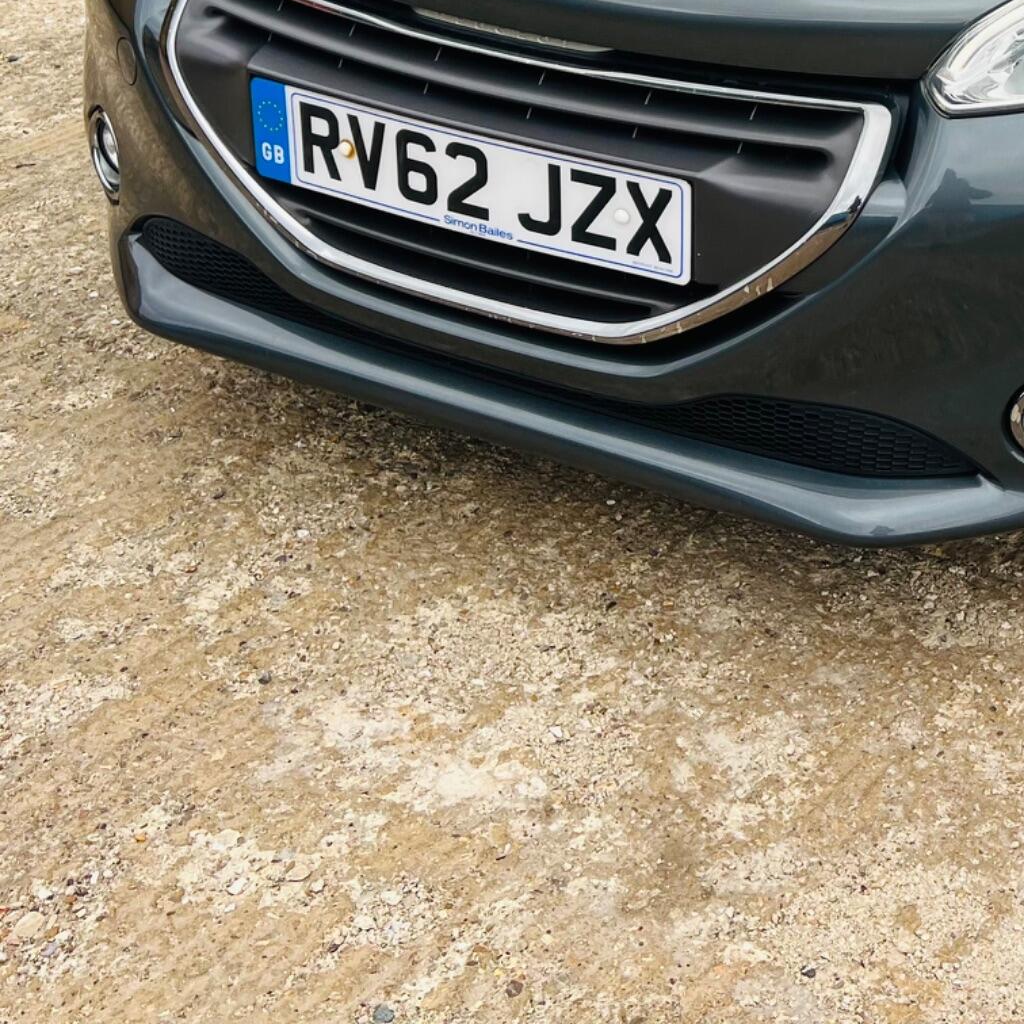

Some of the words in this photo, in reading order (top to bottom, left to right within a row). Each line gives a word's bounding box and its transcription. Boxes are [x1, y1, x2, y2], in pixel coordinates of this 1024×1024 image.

[261, 141, 285, 165] GB
[299, 101, 490, 222] RV62
[517, 163, 673, 265] JZX
[443, 214, 478, 231] Simon
[479, 223, 513, 240] Bailes
